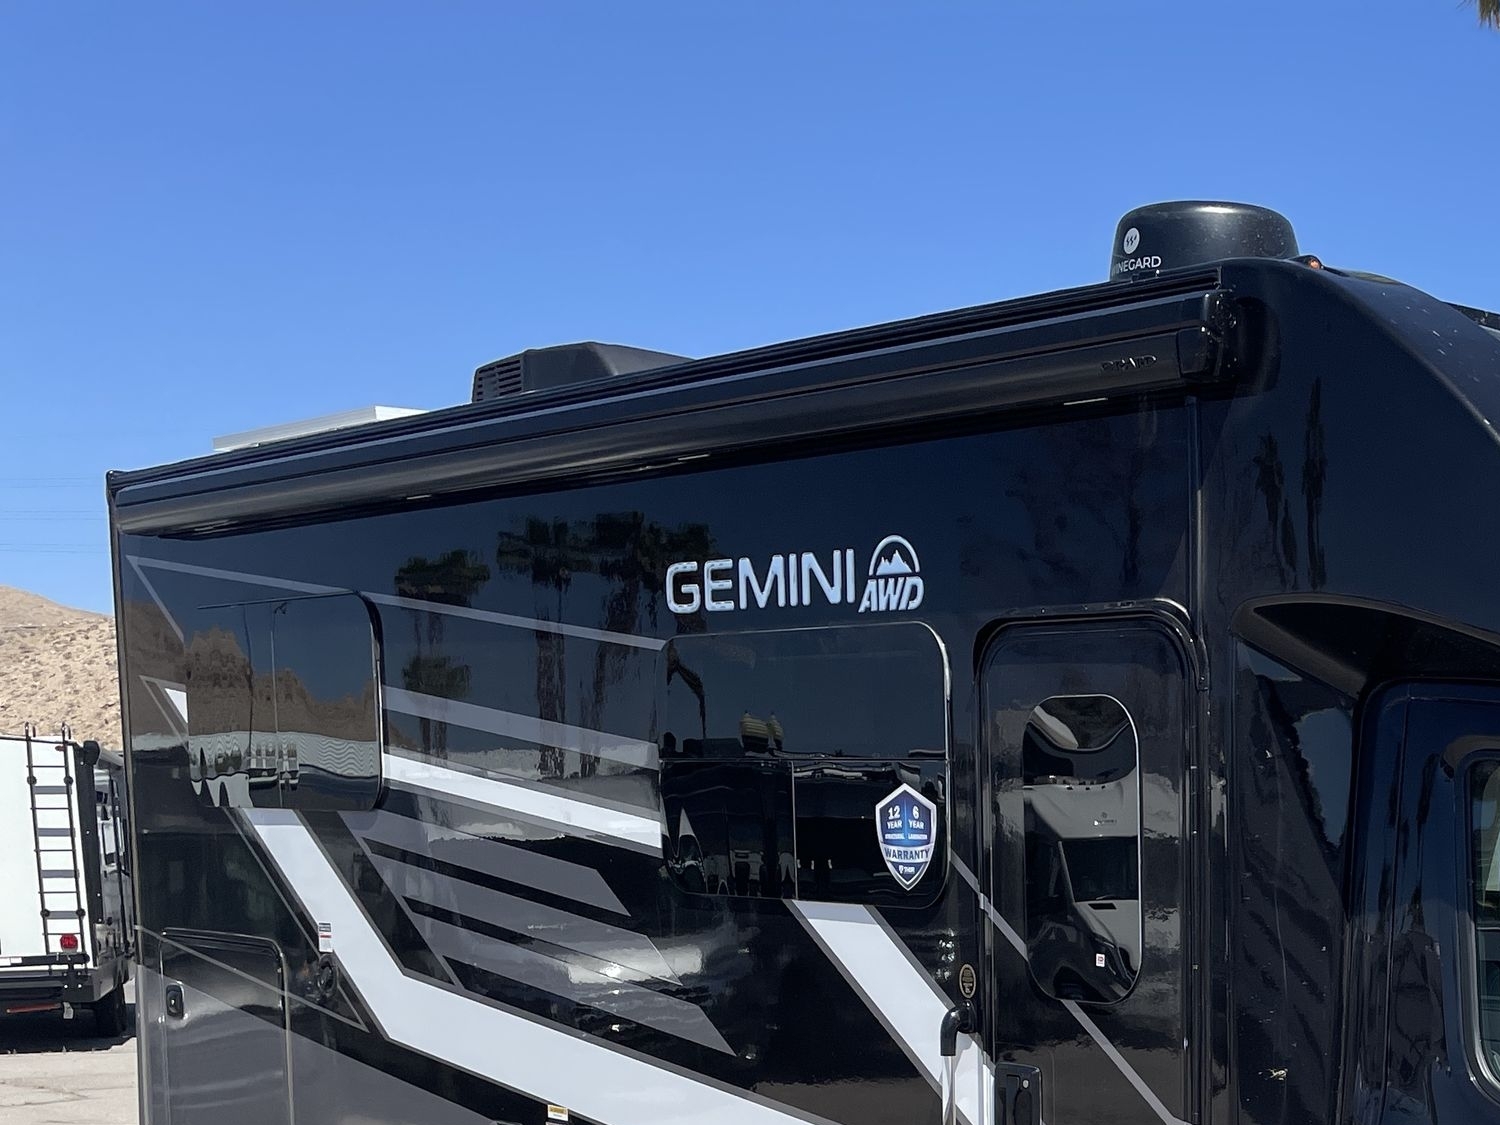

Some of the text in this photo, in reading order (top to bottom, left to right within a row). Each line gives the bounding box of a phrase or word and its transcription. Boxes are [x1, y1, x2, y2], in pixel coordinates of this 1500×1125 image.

[665, 548, 925, 614] GEMINI AWD
[888, 805, 901, 820] 12
[912, 805, 920, 819] 6
[887, 820, 902, 829] YEAR
[908, 820, 924, 829] YEAR
[885, 848, 930, 860] WARRANTY
